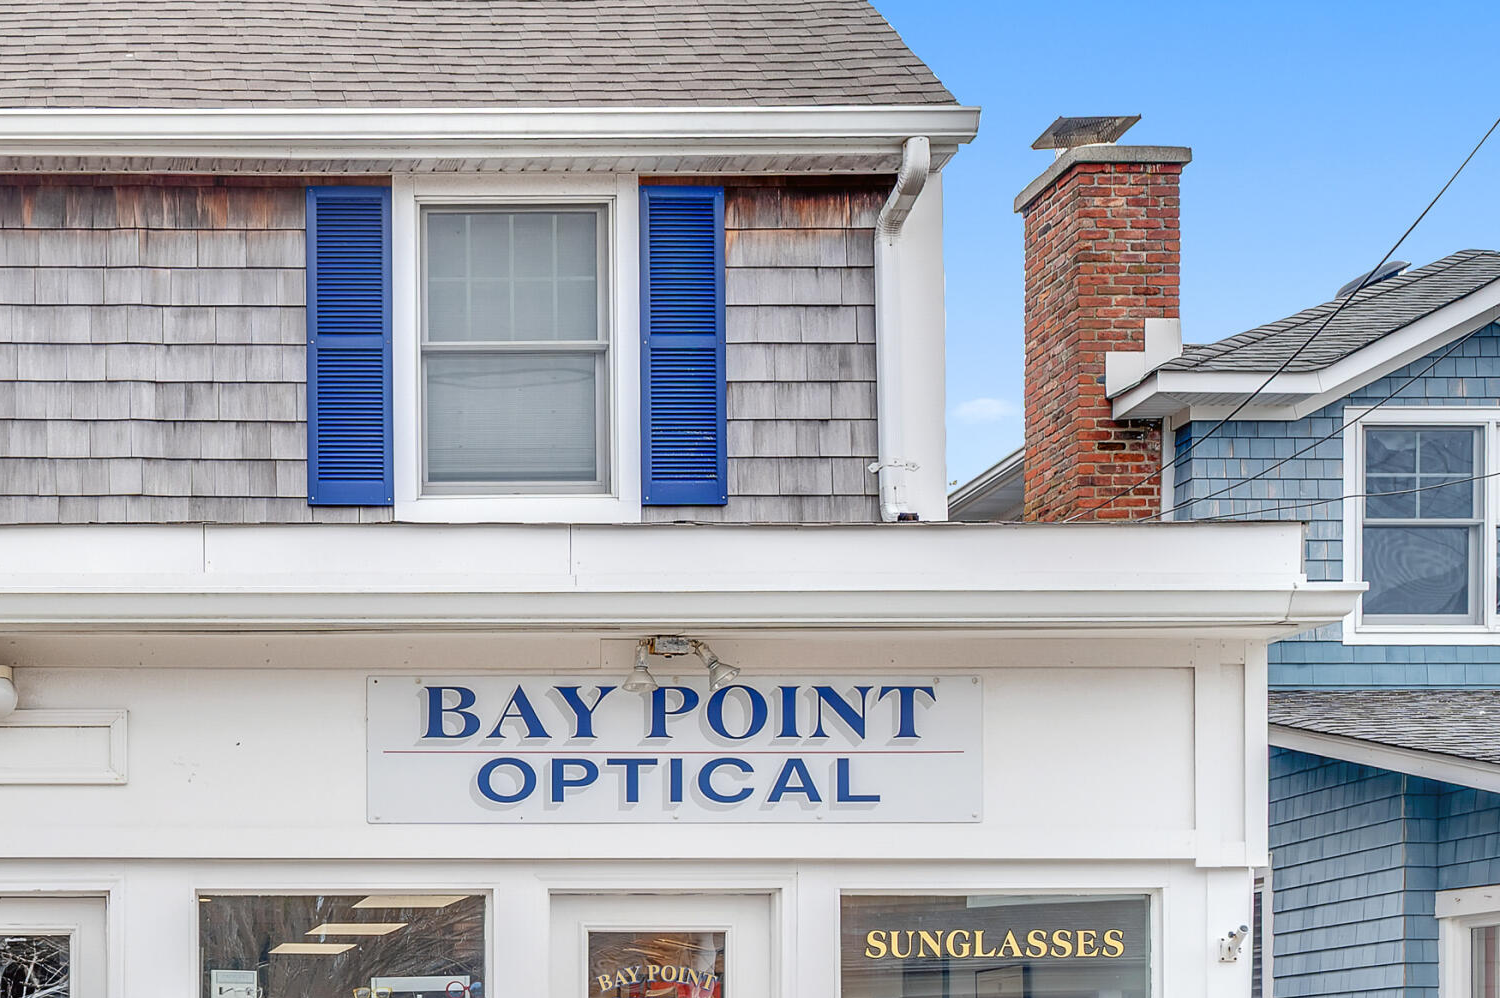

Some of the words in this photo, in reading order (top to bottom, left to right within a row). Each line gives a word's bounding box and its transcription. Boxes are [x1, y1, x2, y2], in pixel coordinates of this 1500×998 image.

[420, 684, 618, 740] BAY
[646, 684, 937, 740] POINT
[476, 757, 881, 804] OPTICAL
[864, 928, 1126, 960] SUNGLASSES
[596, 965, 641, 993] BAY
[646, 964, 718, 991] POINT
